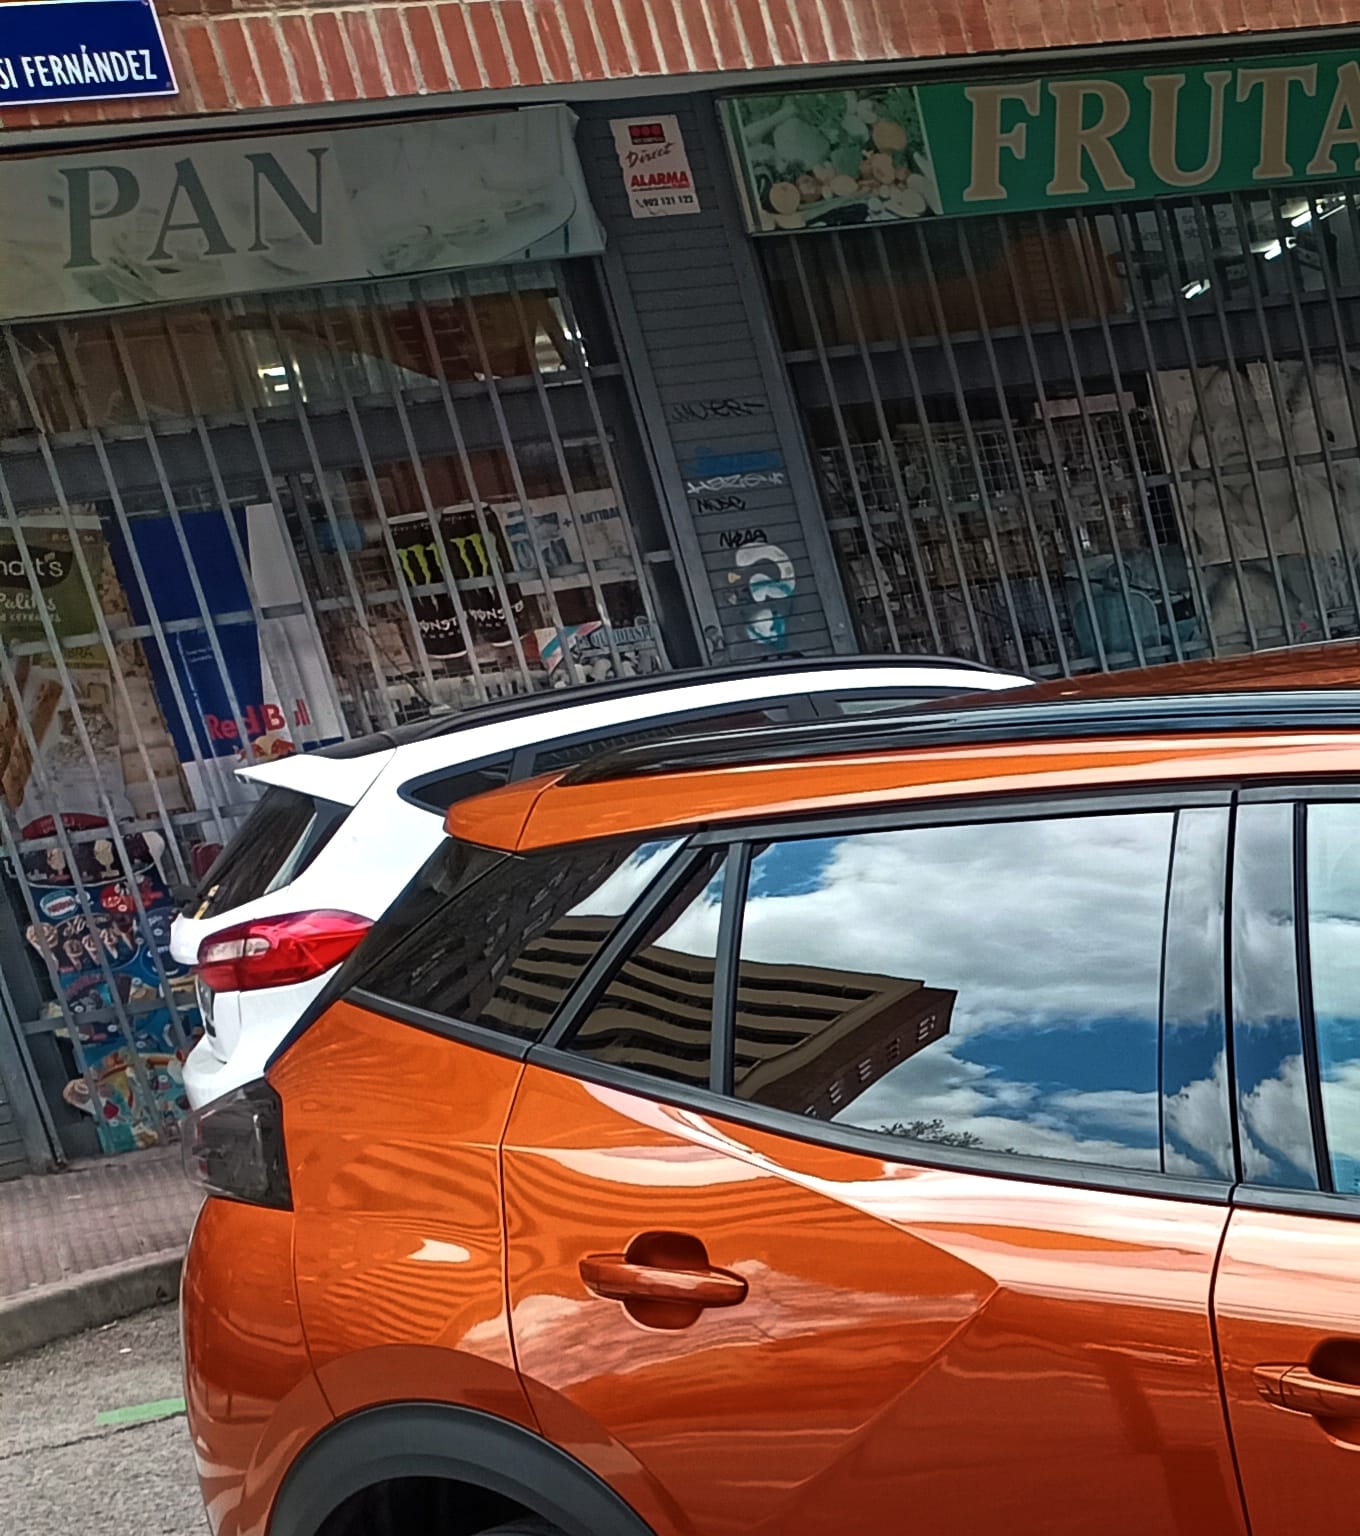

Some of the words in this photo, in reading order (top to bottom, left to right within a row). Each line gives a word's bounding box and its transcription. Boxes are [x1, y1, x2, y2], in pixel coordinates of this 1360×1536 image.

[21, 44, 158, 88] FERNÁNDEZ
[630, 171, 690, 188] ALARMA
[58, 147, 329, 269] PAN
[204, 704, 262, 741] Red
[261, 698, 312, 732] Bll
